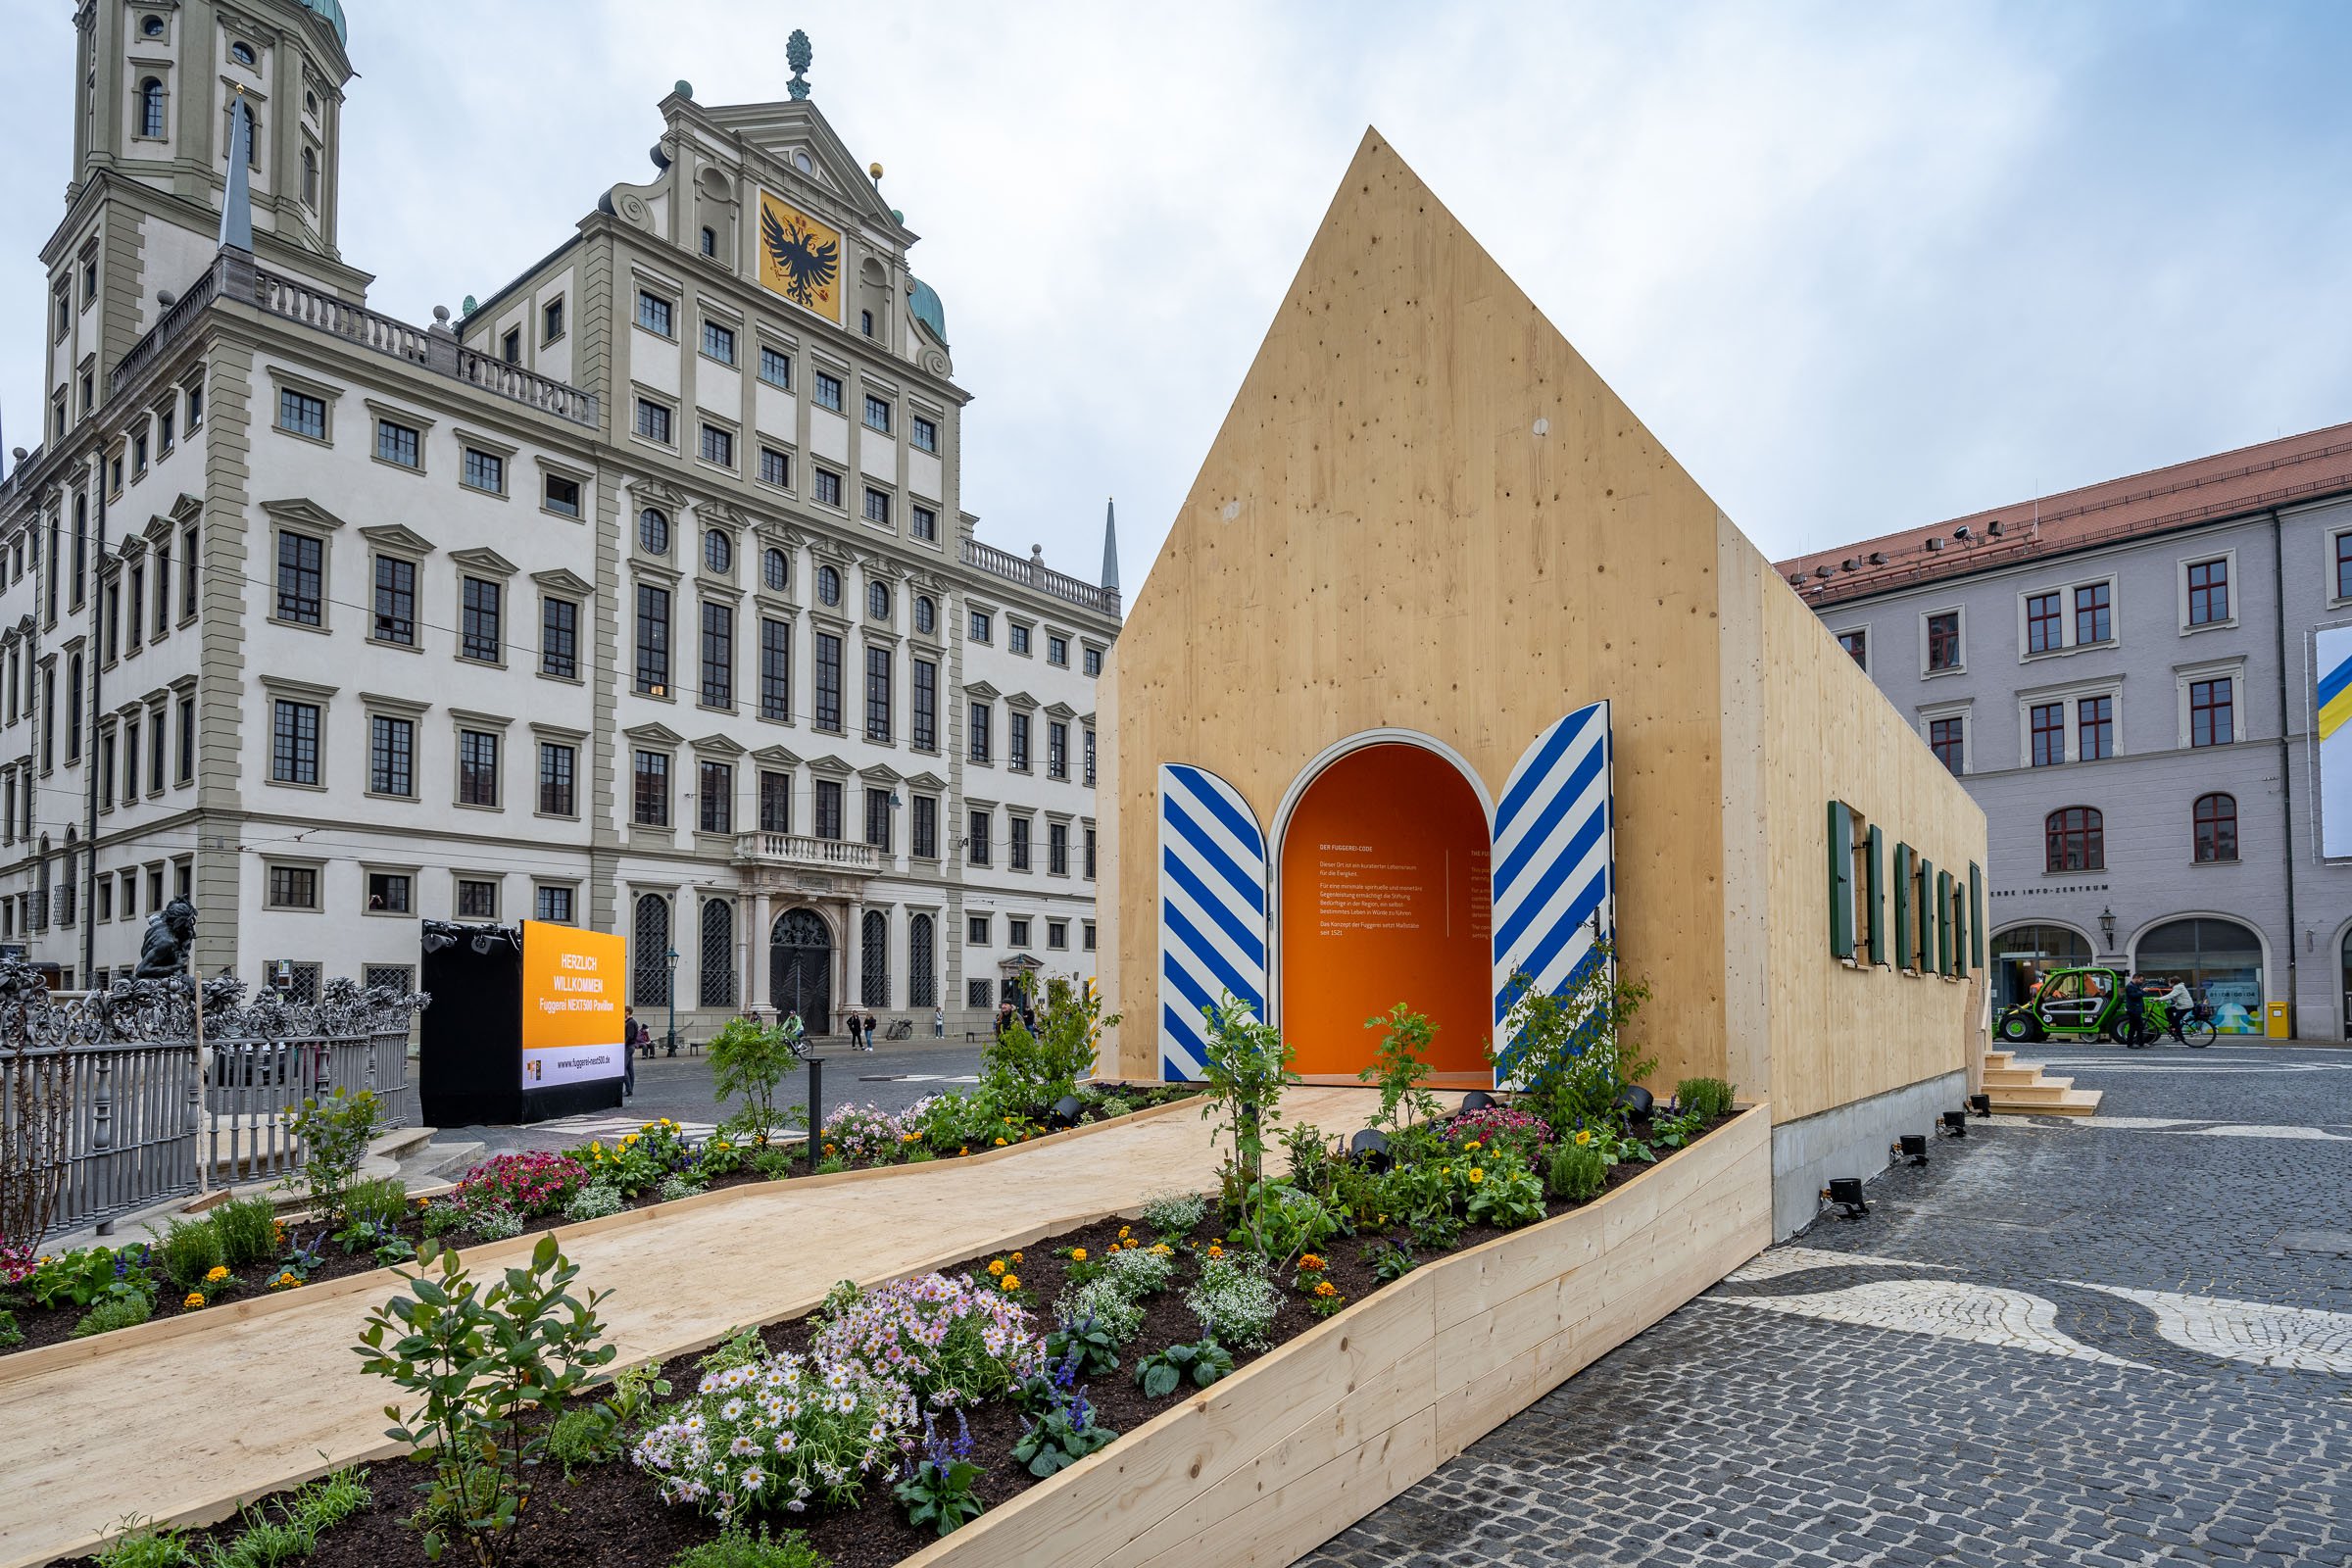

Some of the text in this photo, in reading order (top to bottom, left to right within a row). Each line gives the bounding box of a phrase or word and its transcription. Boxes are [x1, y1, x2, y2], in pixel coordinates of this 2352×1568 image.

[2023, 884, 2108, 895] INFO-ZENTRUM
[561, 953, 597, 971] HERZLICH
[553, 976, 603, 993] WILLKOMMEN
[539, 997, 614, 1014] Fuggerei NEXT500 Pavillon
[557, 1055, 610, 1070] www.fuggerei-next500.de
